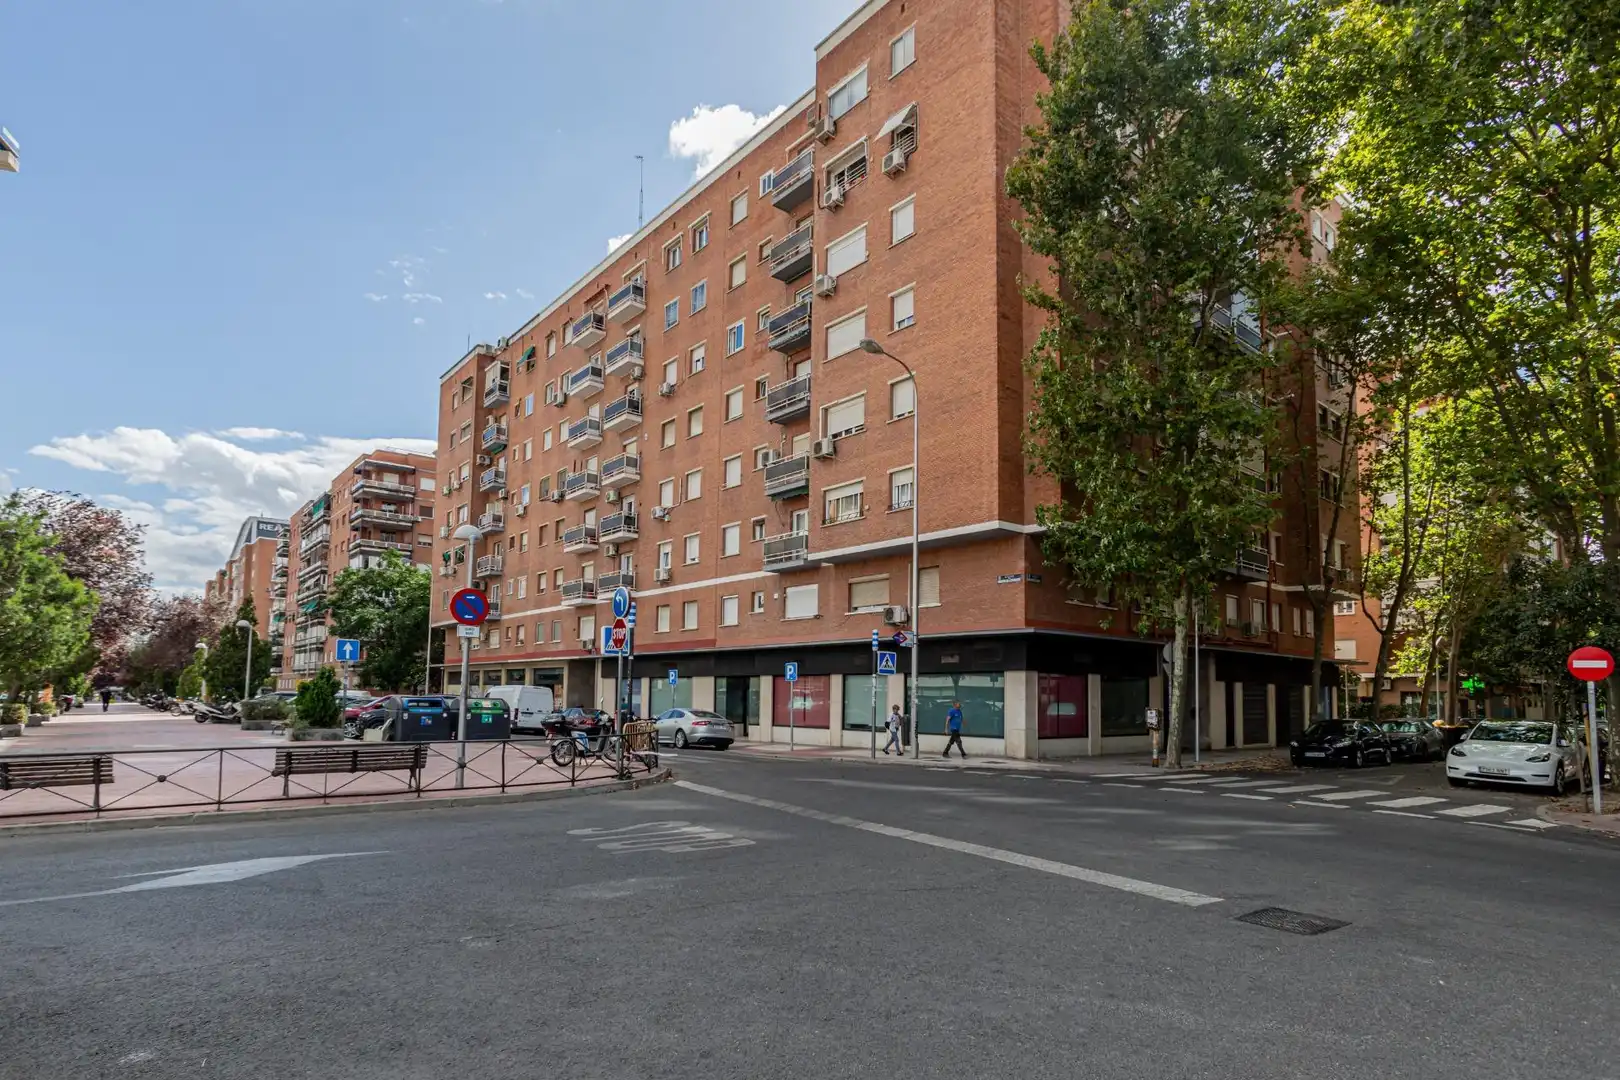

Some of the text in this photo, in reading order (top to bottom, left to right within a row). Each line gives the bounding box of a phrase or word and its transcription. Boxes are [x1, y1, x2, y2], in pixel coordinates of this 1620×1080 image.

[613, 627, 626, 640] STOP
[786, 664, 795, 680] P
[566, 820, 757, 854] STOP
